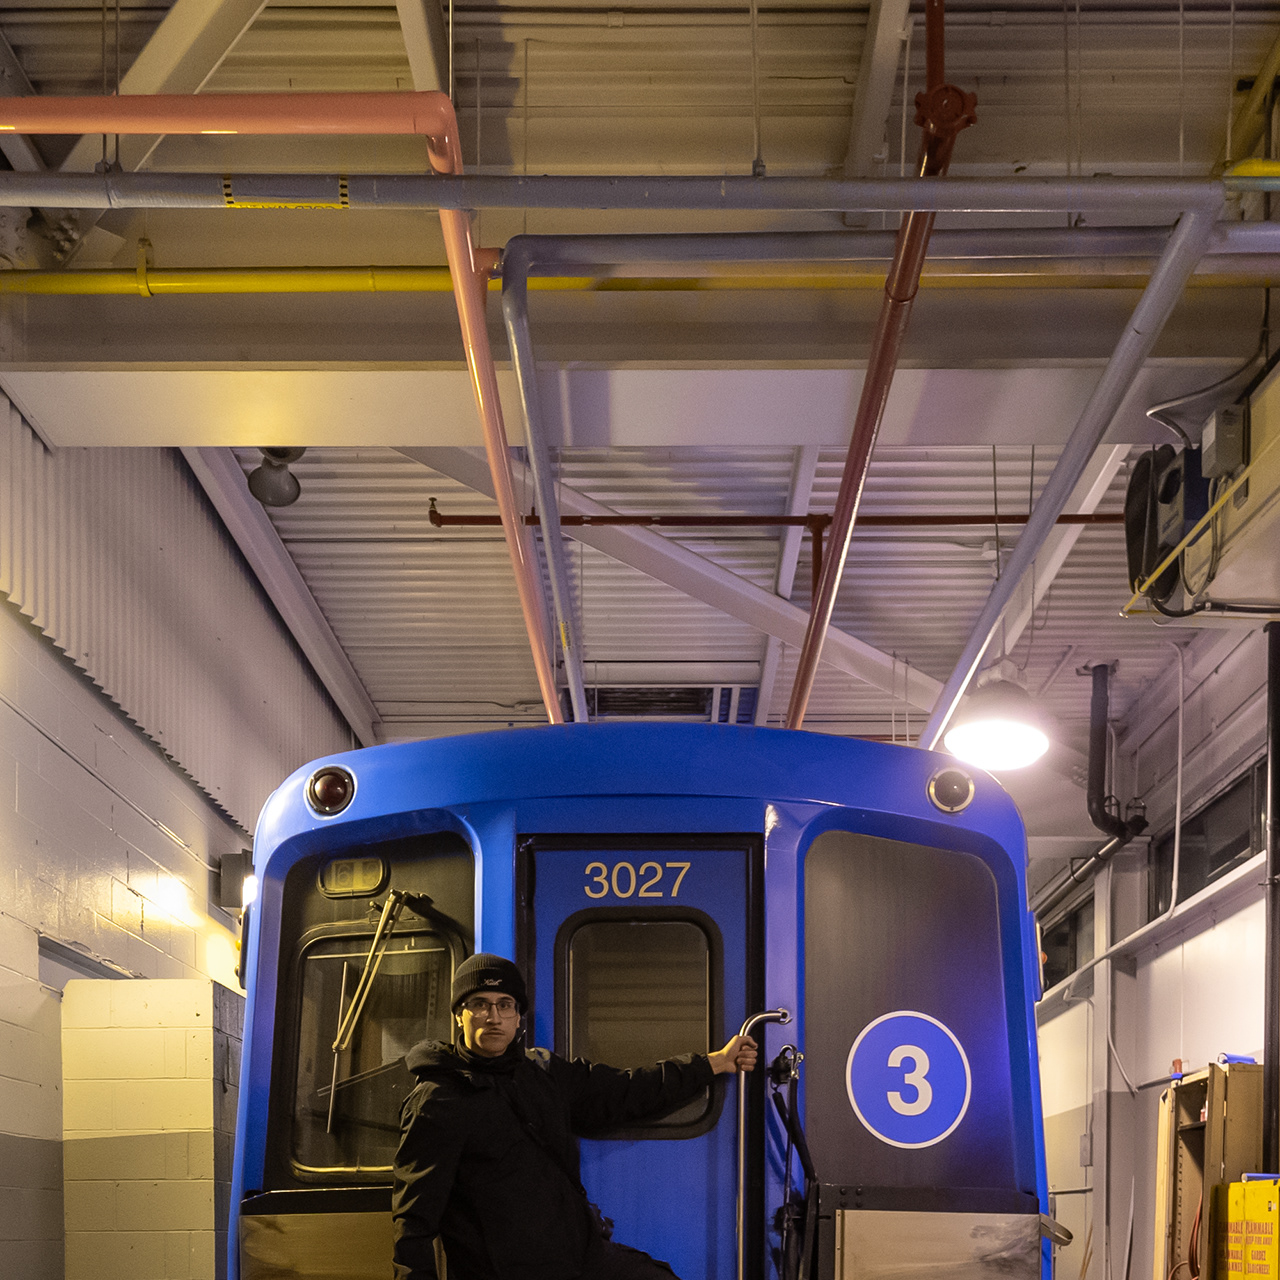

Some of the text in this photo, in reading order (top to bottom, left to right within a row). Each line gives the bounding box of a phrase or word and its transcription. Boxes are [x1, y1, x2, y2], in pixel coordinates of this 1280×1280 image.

[584, 861, 691, 899] 3027
[887, 1044, 933, 1116] 3
[1245, 1221, 1274, 1235] FLAMMABLE
